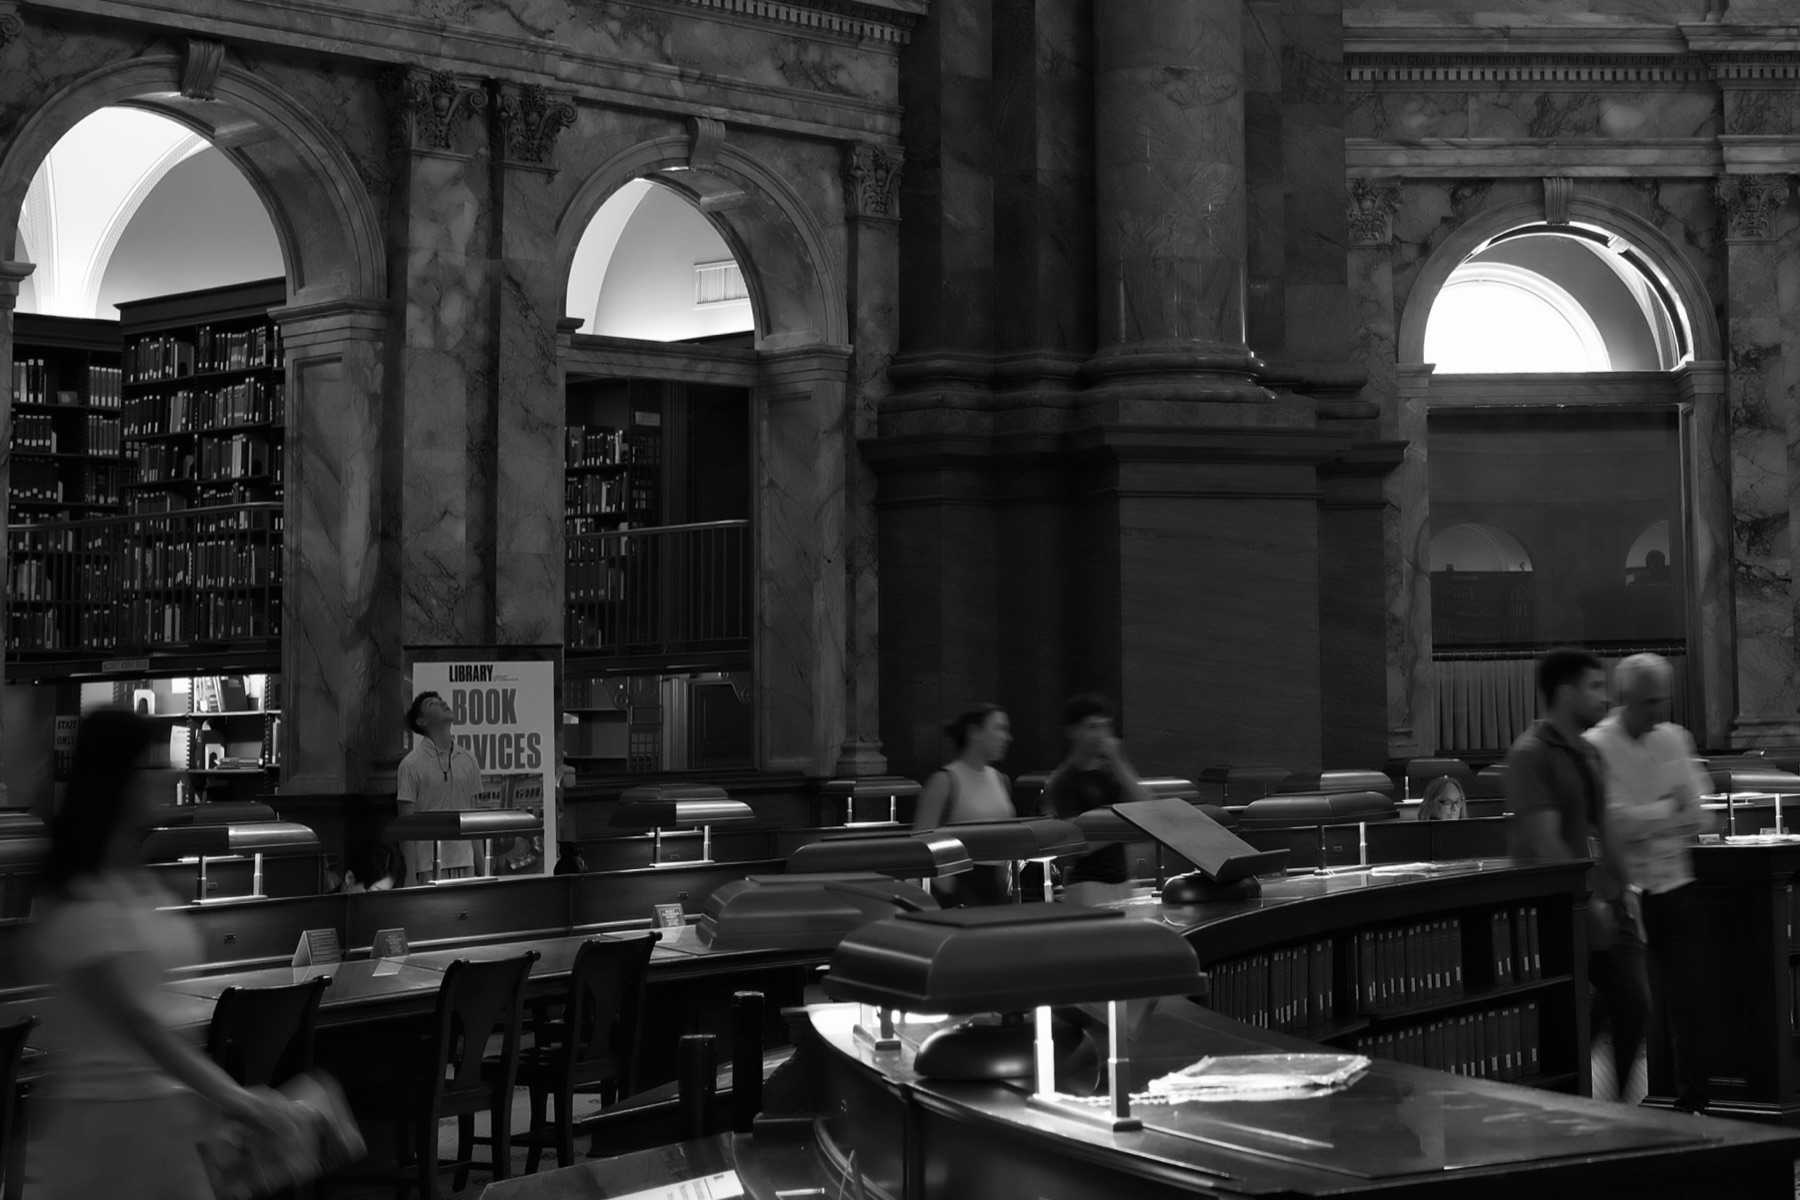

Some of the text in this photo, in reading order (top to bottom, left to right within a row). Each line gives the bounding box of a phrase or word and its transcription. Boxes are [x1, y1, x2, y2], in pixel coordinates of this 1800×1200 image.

[449, 664, 493, 682] LIBRARY
[452, 688, 517, 726] BOOK
[57, 720, 77, 729] STAFF
[57, 736, 74, 745] ONLY
[452, 733, 541, 770] VICES
